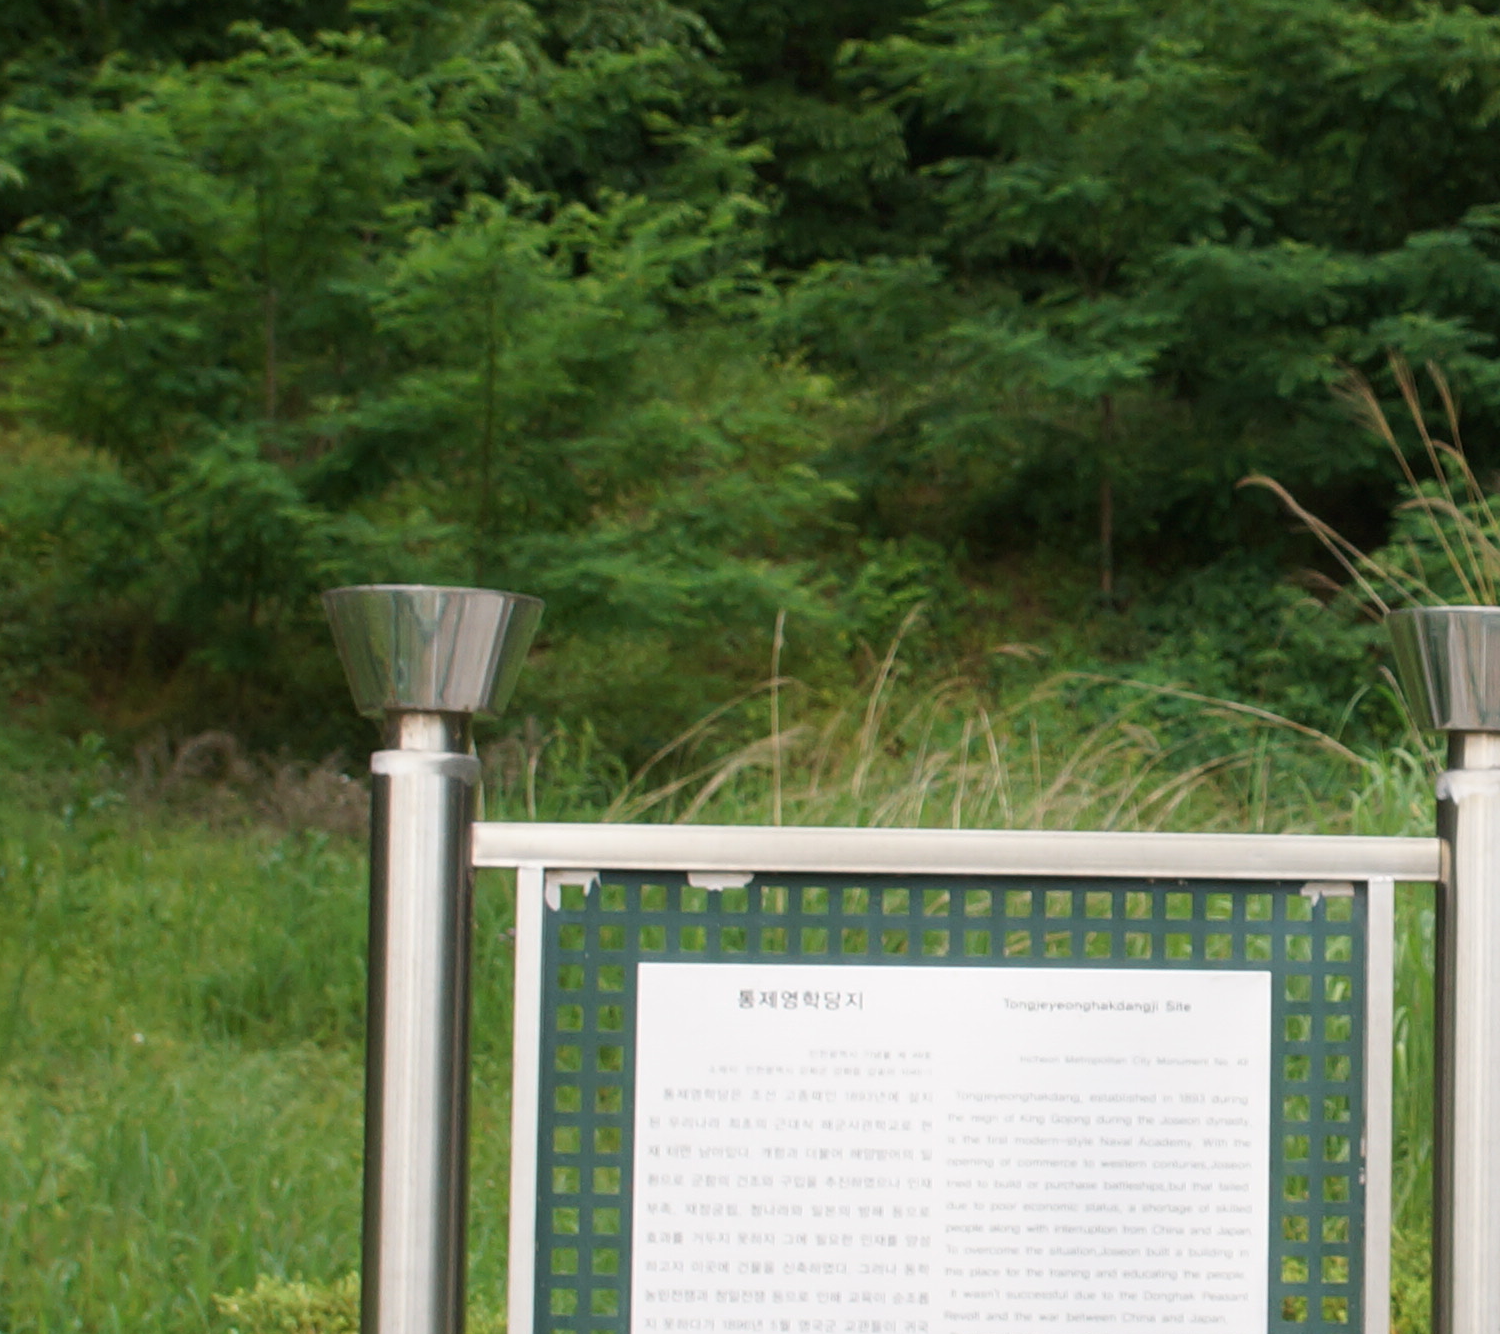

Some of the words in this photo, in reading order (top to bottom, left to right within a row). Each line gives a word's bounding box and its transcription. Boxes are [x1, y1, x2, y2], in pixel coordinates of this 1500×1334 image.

[738, 990, 863, 1009] 통제영학당지
[1004, 998, 1158, 1012] Tongjeyeonghakdangji
[1165, 1000, 1191, 1012] Site
